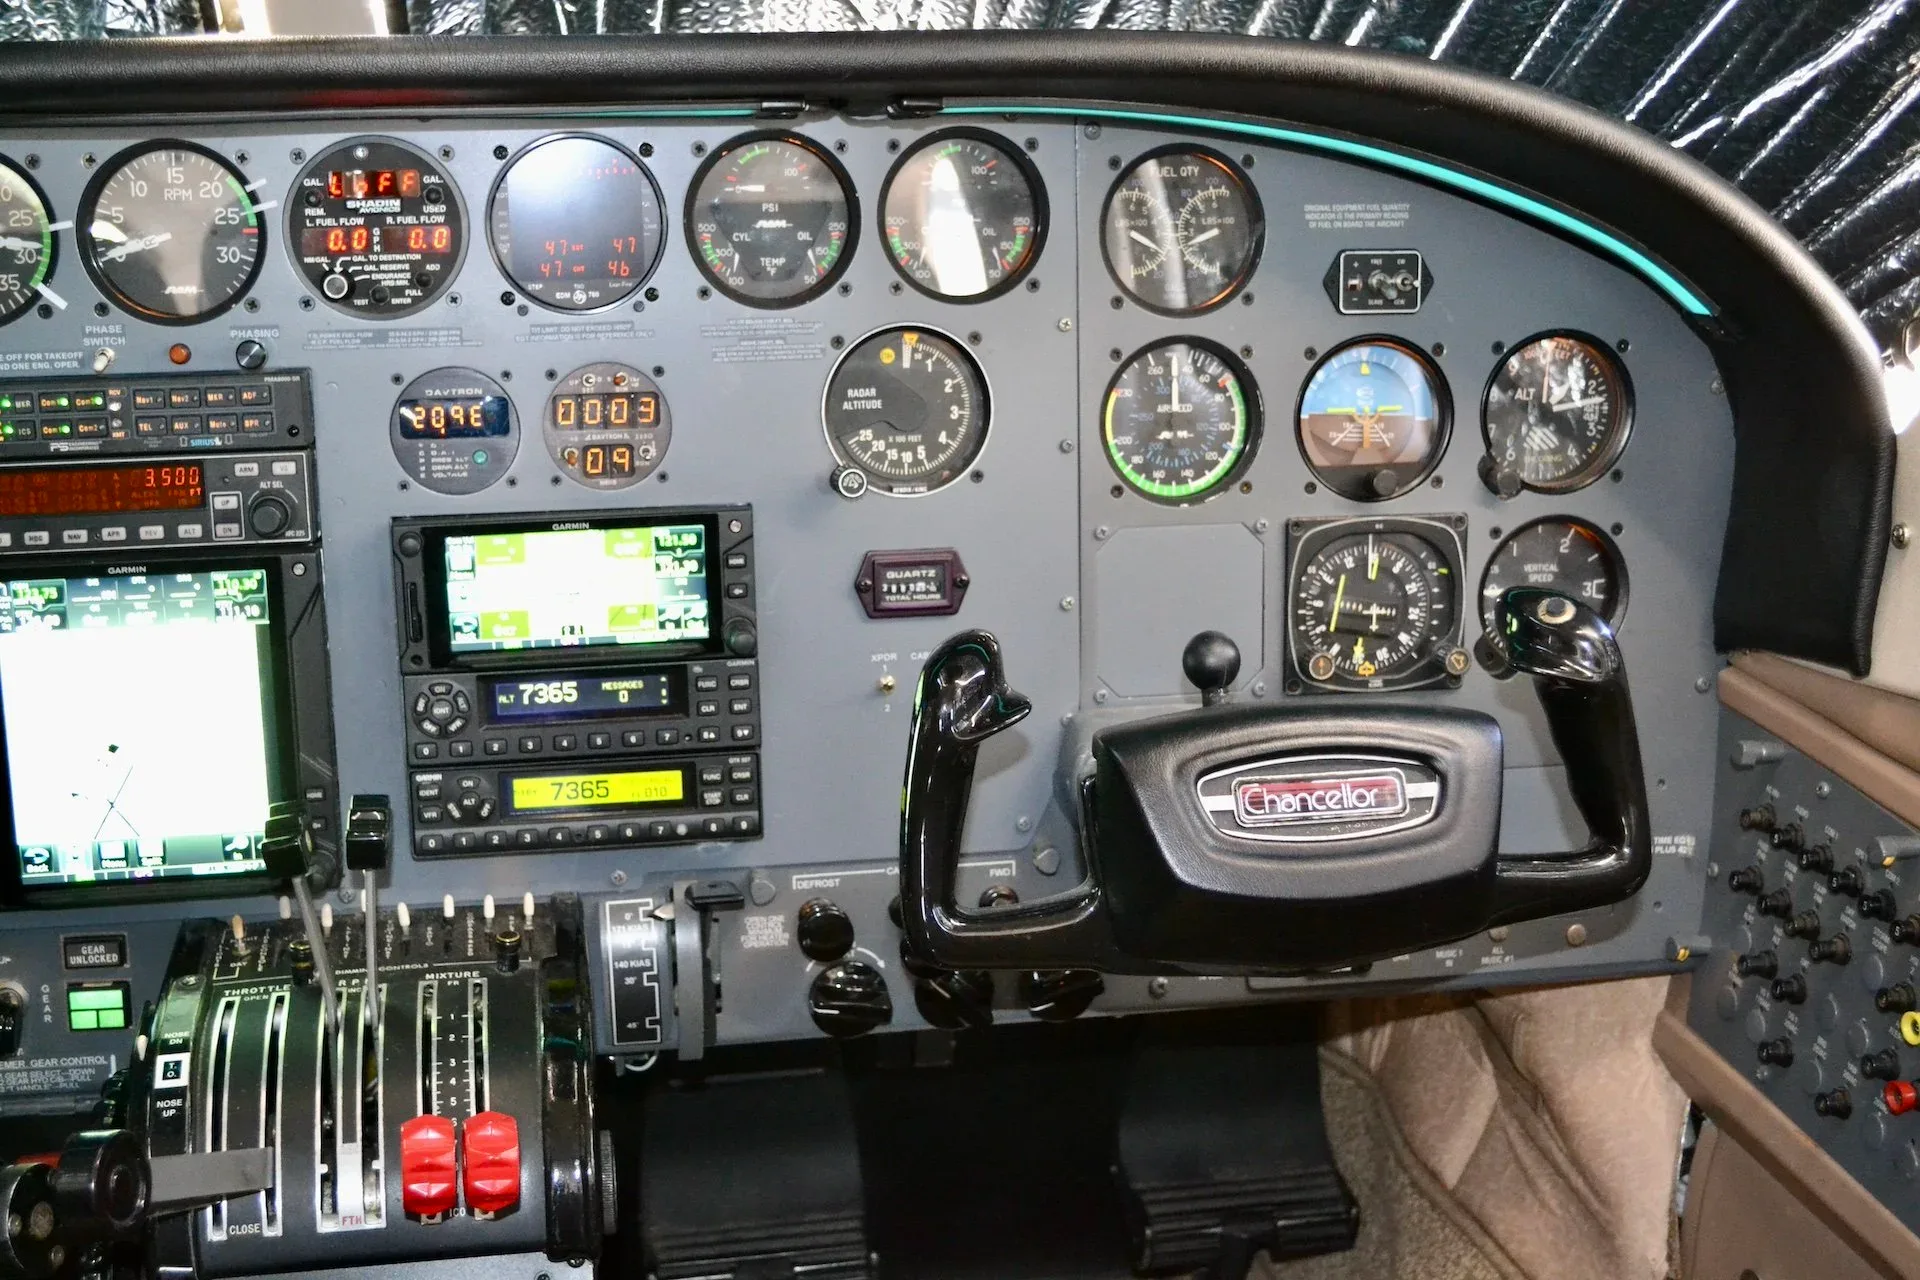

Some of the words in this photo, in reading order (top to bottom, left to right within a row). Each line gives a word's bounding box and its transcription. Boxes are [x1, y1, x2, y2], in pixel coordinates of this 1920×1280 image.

[167, 168, 184, 184] 15
[784, 168, 798, 176] 100
[971, 167, 987, 175] 100
[1180, 166, 1199, 176] QTY
[131, 181, 148, 197] 10
[200, 183, 223, 198] 20
[164, 189, 192, 201] RPM
[346, 200, 401, 209] SHADIN
[423, 205, 446, 213] USED
[762, 203, 778, 212] PSI
[9, 209, 34, 227] 25
[112, 207, 124, 224] 5
[215, 208, 239, 225] 25
[397, 216, 419, 224] FUEL
[420, 215, 445, 223] FLOW
[316, 218, 338, 226] FUEL
[340, 217, 365, 225] FLOW
[328, 228, 367, 251] 0.0
[410, 228, 447, 249] 0.0
[733, 232, 750, 241] CYL
[797, 232, 812, 241] OIL
[14, 248, 37, 264] 30
[216, 247, 240, 263] 30
[760, 257, 786, 266] TEMP
[380, 263, 410, 271] RESERVE
[371, 272, 411, 280] ENDURANCE
[729, 277, 744, 285] 100
[804, 276, 816, 284] 50
[391, 297, 411, 305] ENTER
[85, 325, 122, 335] PHASE
[231, 328, 280, 339] PHASING
[83, 337, 126, 347] SWITCH
[9, 353, 22, 361] OFF
[25, 352, 42, 360] FOR
[45, 351, 83, 360] TAKEOFF
[925, 360, 932, 372] 1
[944, 379, 953, 393] 2
[1588, 380, 1596, 394] 2
[425, 388, 483, 396] DAVTRON
[847, 388, 876, 398] RADAR
[1514, 388, 1536, 400] ALT
[843, 400, 882, 410] ALTITUDE
[950, 406, 959, 419] 3
[1587, 423, 1596, 436] 3
[859, 429, 873, 441] 25
[938, 431, 947, 444] 4
[190, 438, 215, 447] SIRIUS
[872, 440, 885, 451] 20
[886, 449, 898, 460] 15
[917, 446, 926, 460] 5
[1506, 448, 1516, 461] 6
[1568, 444, 1577, 456] 4
[901, 452, 913, 463] 10
[260, 481, 271, 489] ALT
[272, 480, 283, 488] SEL
[552, 522, 590, 531] GARMIN
[1560, 539, 1569, 553] 2
[108, 565, 146, 575] GARMIN
[1524, 563, 1559, 573] VERTICAL
[886, 570, 936, 579] QUARTZ
[1528, 574, 1554, 583] SPEED
[1582, 582, 1591, 597] 3
[871, 653, 897, 662] XPDR
[602, 680, 644, 691] MESSAGES
[697, 680, 717, 688] FUNC
[730, 678, 749, 686] CRSR
[434, 686, 446, 694] ON
[498, 695, 515, 704] ALT
[518, 681, 579, 705] 7365
[433, 707, 450, 715] IDNT
[701, 705, 716, 713] CLR
[733, 703, 747, 711] ENT
[884, 704, 891, 712] 2
[423, 747, 429, 756] 0
[458, 745, 464, 754] 1
[492, 743, 499, 752] 2
[527, 741, 533, 750] 3
[561, 739, 568, 747] 4
[630, 735, 637, 744] 6
[664, 733, 671, 741] 7
[416, 774, 442, 782] GARMIN
[550, 780, 609, 801] 7365
[463, 798, 476, 806] ALT
[1245, 783, 1379, 815] Chancellor
[428, 839, 435, 848] 0
[461, 837, 467, 846] 1
[492, 836, 499, 844] 2
[524, 834, 531, 842] 3
[556, 832, 562, 841] 4
[595, 830, 601, 839] 5
[626, 828, 633, 837] 6
[657, 826, 664, 835] 7
[710, 823, 717, 832] 8
[741, 821, 748, 830] 9
[989, 868, 1010, 877] FWD
[797, 878, 840, 889] DEFROST
[1832, 878, 1838, 887] 5
[1894, 926, 1900, 936] 5
[81, 944, 106, 955] GEAR
[69, 954, 118, 965] UNLOCKED
[630, 958, 651, 967] KIAS
[378, 963, 429, 972] CONTROLS
[425, 970, 480, 980] MIXTURE
[224, 984, 292, 996] THROTTLE
[41, 984, 52, 1023] GEAR
[30, 1058, 58, 1068] GEAR
[60, 1056, 108, 1066] CONTROL
[449, 1058, 456, 1067] 3
[5, 1071, 27, 1079] GEAR
[450, 1078, 456, 1086] 4
[156, 1099, 183, 1108] NOSE
[450, 1096, 457, 1106] 5
[163, 1109, 176, 1118] UP
[229, 1223, 260, 1236] CLOSE
